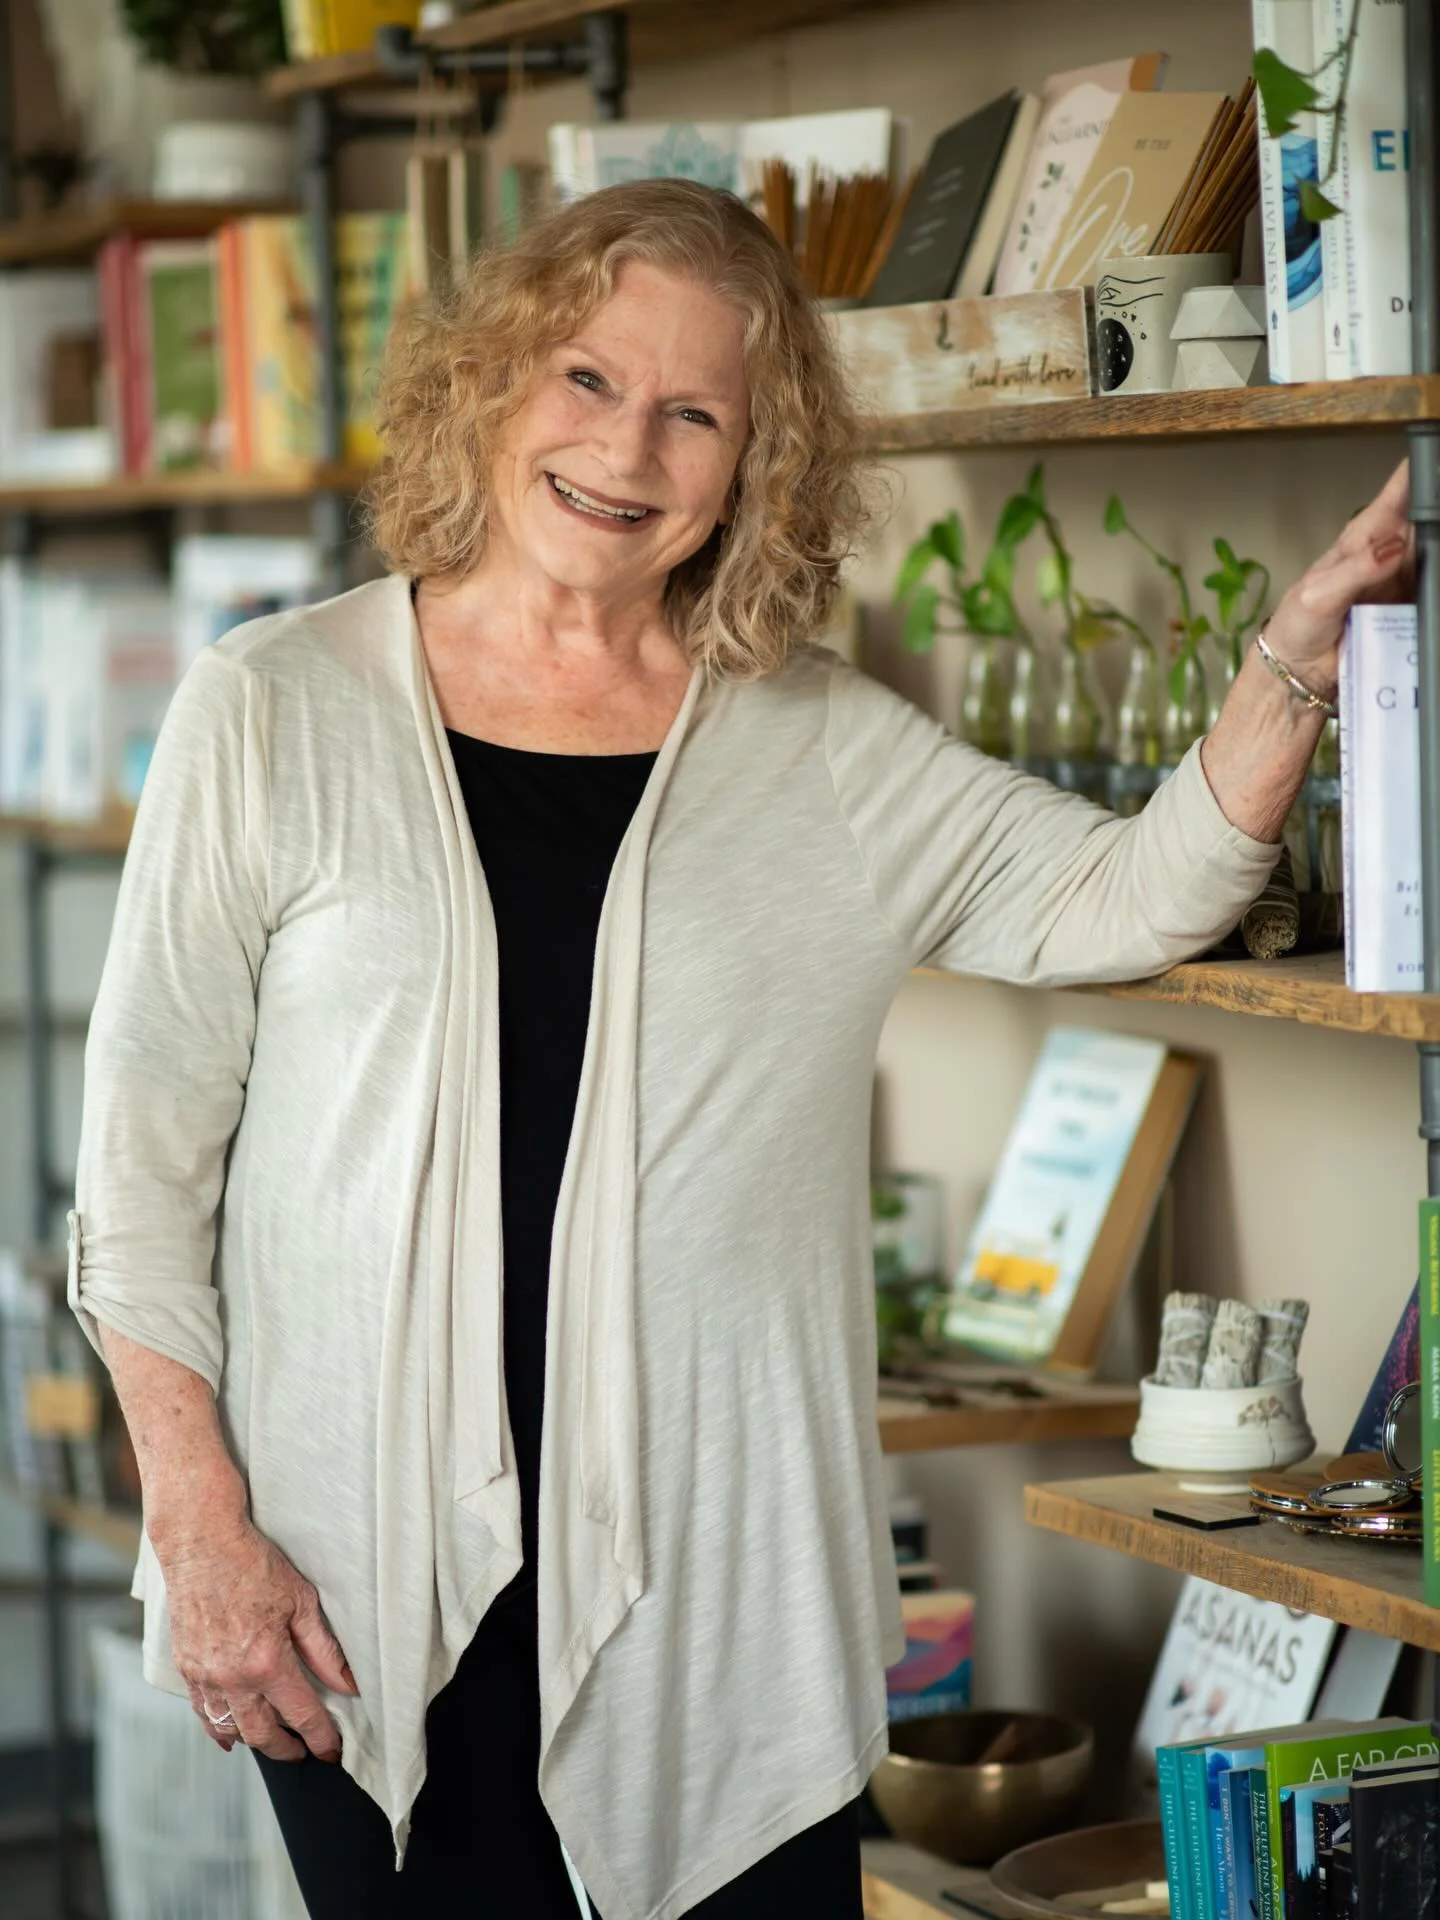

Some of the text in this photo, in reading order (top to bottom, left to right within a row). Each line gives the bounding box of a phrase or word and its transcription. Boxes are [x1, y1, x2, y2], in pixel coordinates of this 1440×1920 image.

[1263, 171, 1279, 295] ALIVENESS
[1037, 352, 1077, 386] love
[1181, 1591, 1303, 1685] ASANAS
[1309, 1757, 1328, 1783] A
[1222, 1797, 1231, 1831] DON'T
[1258, 1791, 1266, 1818] THE
[1167, 1819, 1179, 1881] CELESTINE
[1191, 1825, 1202, 1888] CELESTINE
[1255, 1856, 1264, 1894] Spiritual
[1260, 1821, 1270, 1888] CELESTINE
